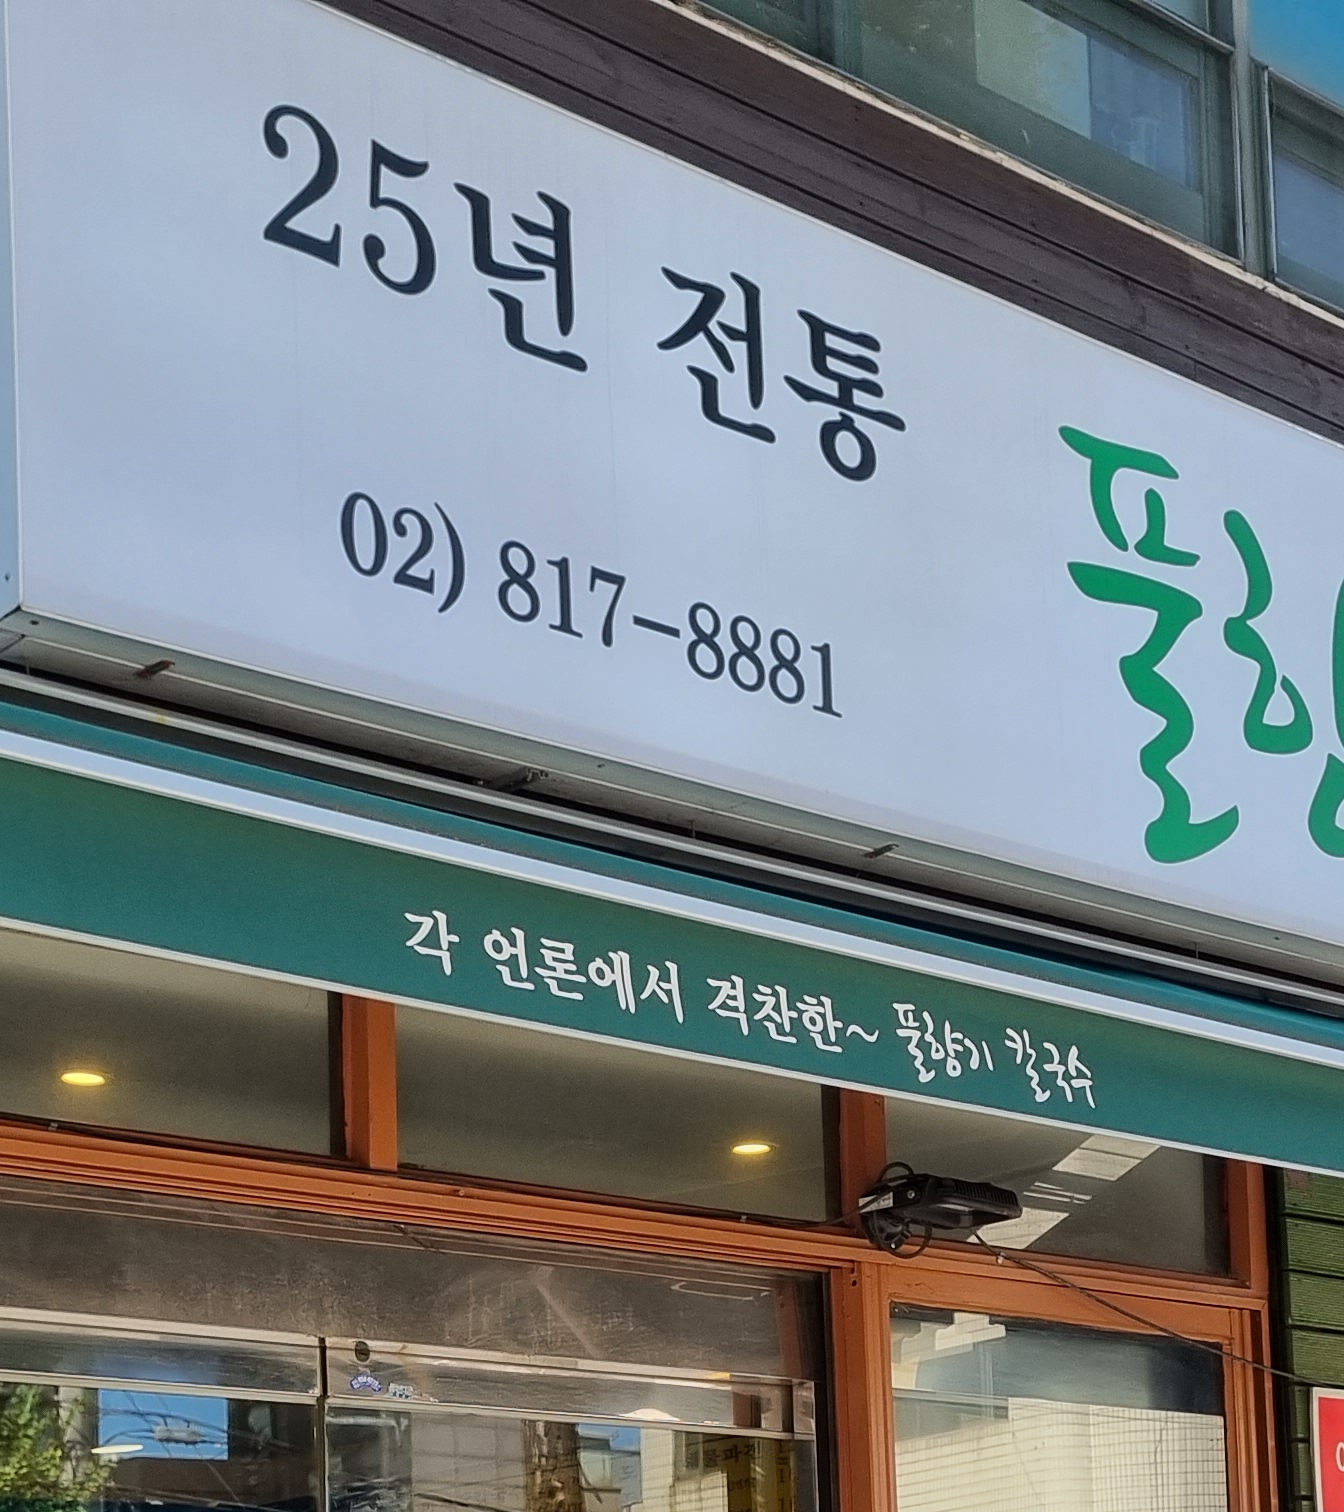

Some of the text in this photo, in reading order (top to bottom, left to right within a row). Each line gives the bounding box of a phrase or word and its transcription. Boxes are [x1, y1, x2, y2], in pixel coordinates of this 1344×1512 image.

[263, 104, 907, 481] 25년 전통
[340, 491, 843, 718] 02) 817-8881
[404, 909, 459, 976] 각
[483, 926, 686, 1024] 언론에서
[894, 1001, 995, 1084] 풀향기
[1005, 1027, 1096, 1110] 칼국수
